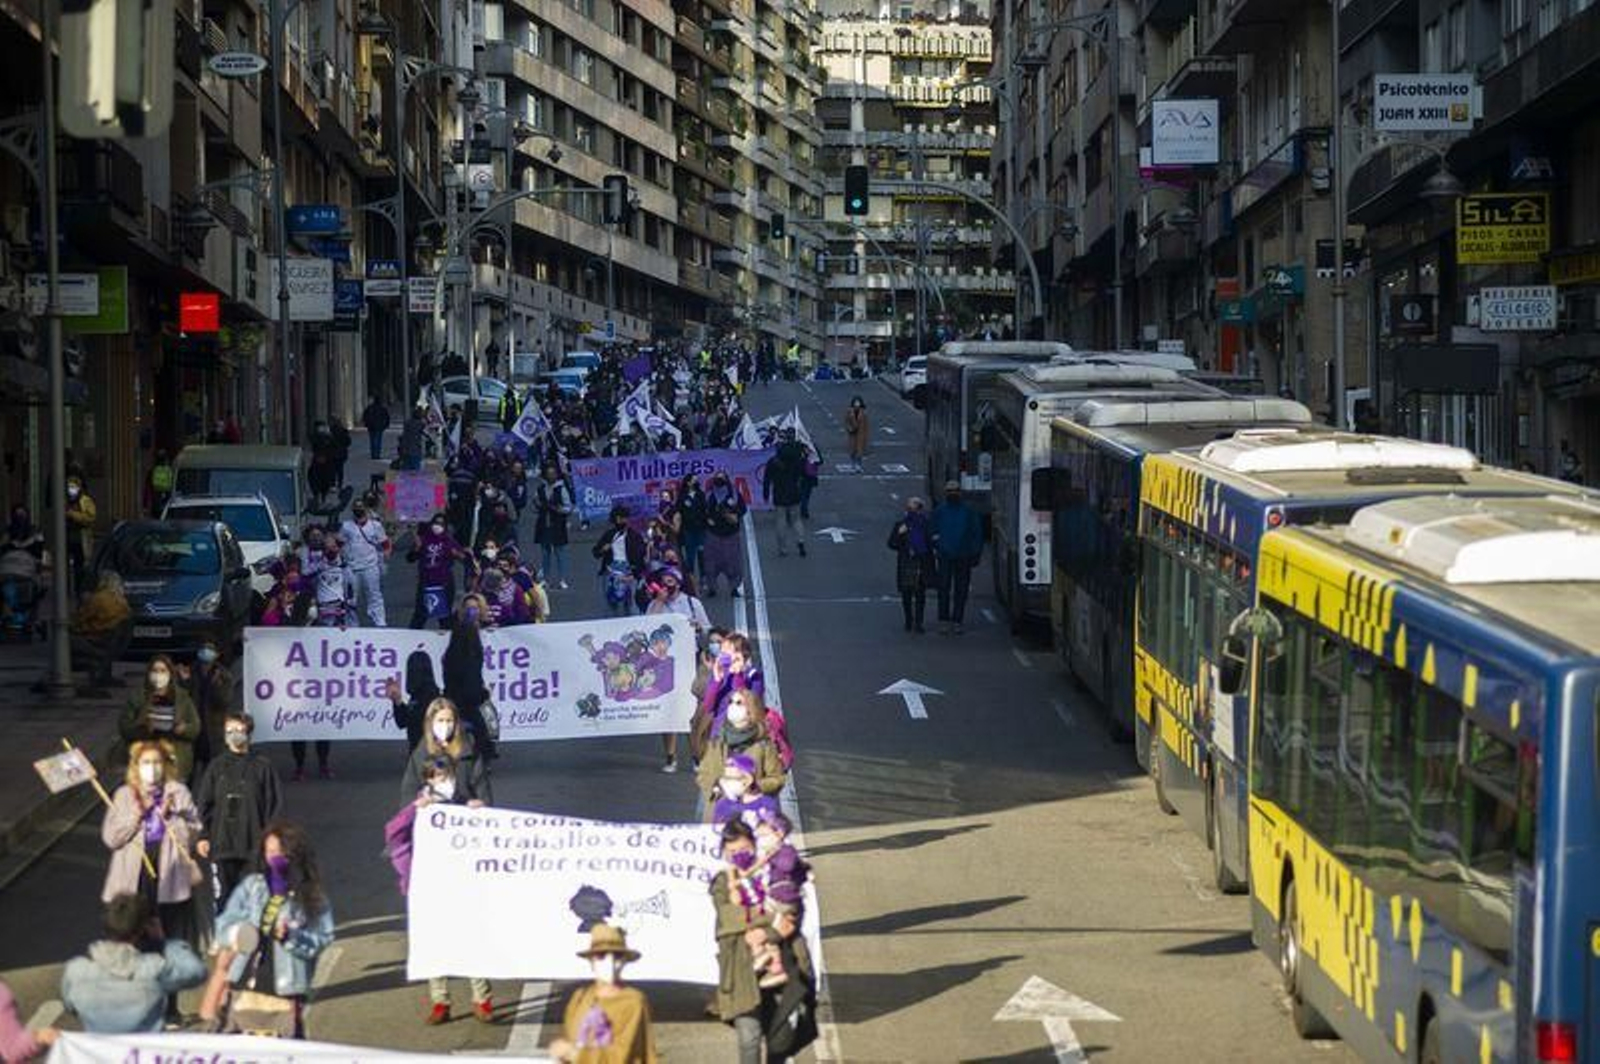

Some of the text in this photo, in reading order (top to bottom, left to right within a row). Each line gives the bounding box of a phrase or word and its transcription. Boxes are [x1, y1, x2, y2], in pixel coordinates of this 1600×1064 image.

[1379, 82, 1470, 96] Psicotécnico
[1379, 107, 1449, 121] JUAN XXIII
[618, 457, 716, 482] Mulleres
[285, 639, 531, 669] A loita tre
[255, 679, 274, 700] o
[286, 671, 402, 705] capital
[273, 706, 377, 731] feminismo
[509, 707, 550, 724] todo
[430, 810, 499, 829] Quen
[450, 831, 723, 860] Os traballos de coid
[475, 854, 570, 873] mellor
